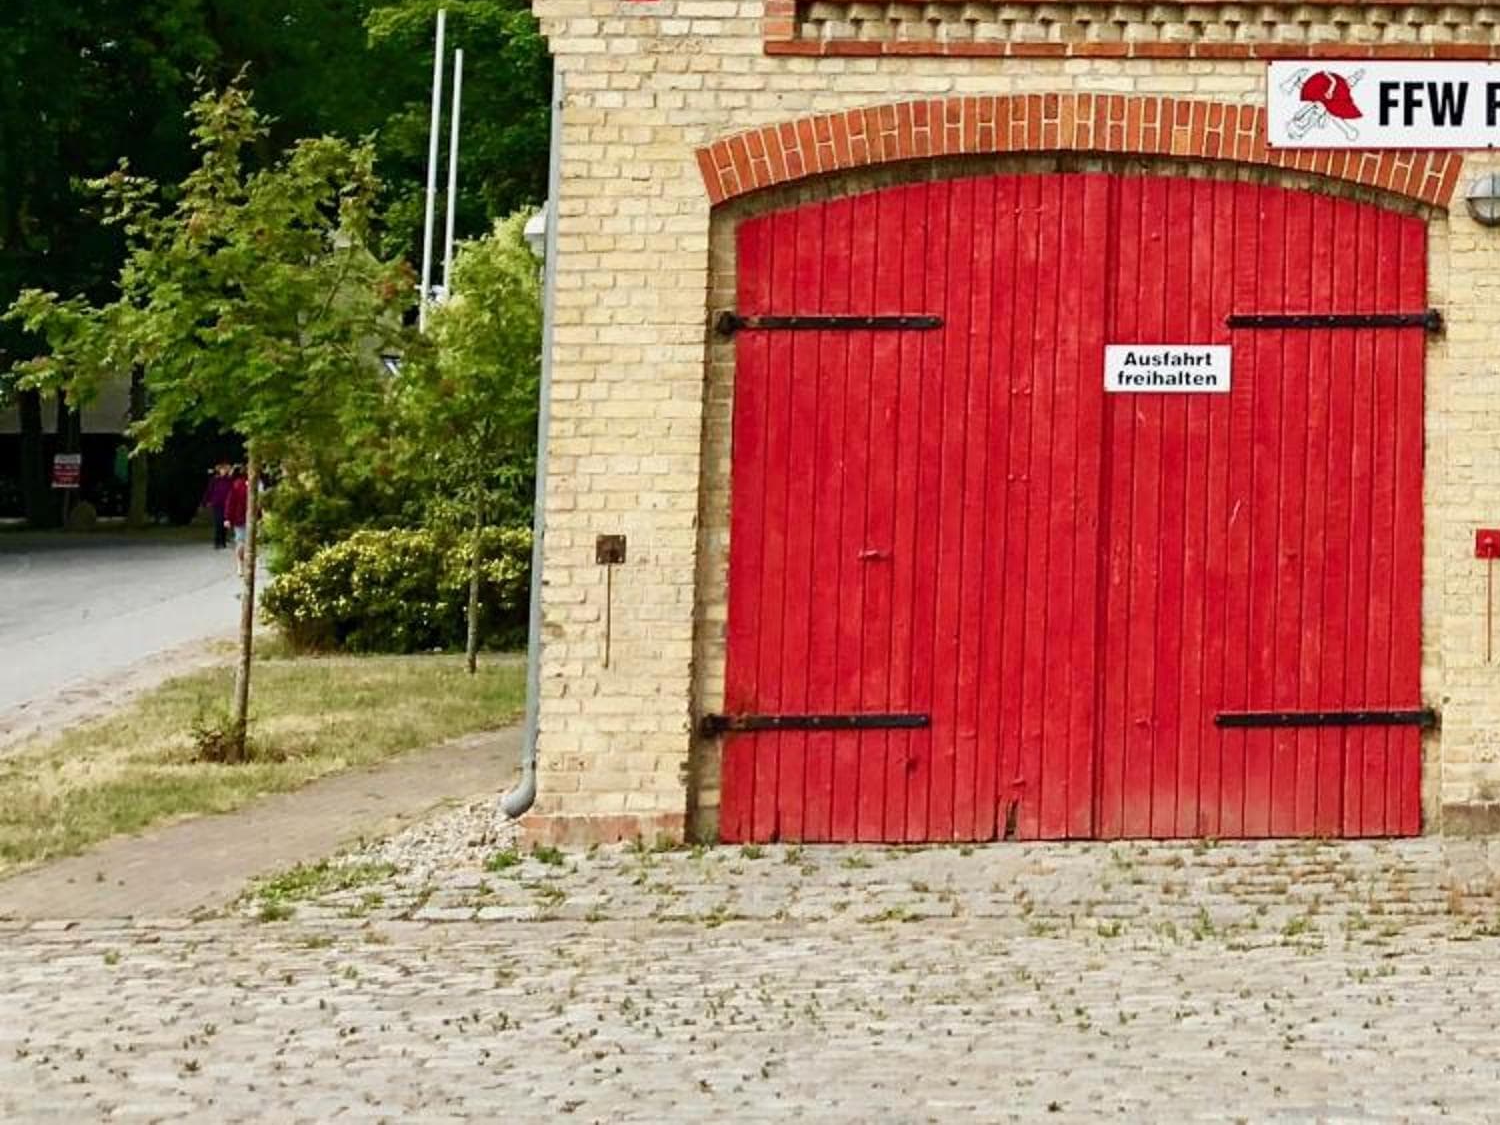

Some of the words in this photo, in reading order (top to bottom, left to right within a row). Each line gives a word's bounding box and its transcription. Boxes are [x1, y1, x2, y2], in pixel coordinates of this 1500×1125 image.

[1379, 81, 1468, 127] FFW
[1123, 351, 1212, 366] Ausfahrt
[1117, 370, 1217, 386] freihalten
